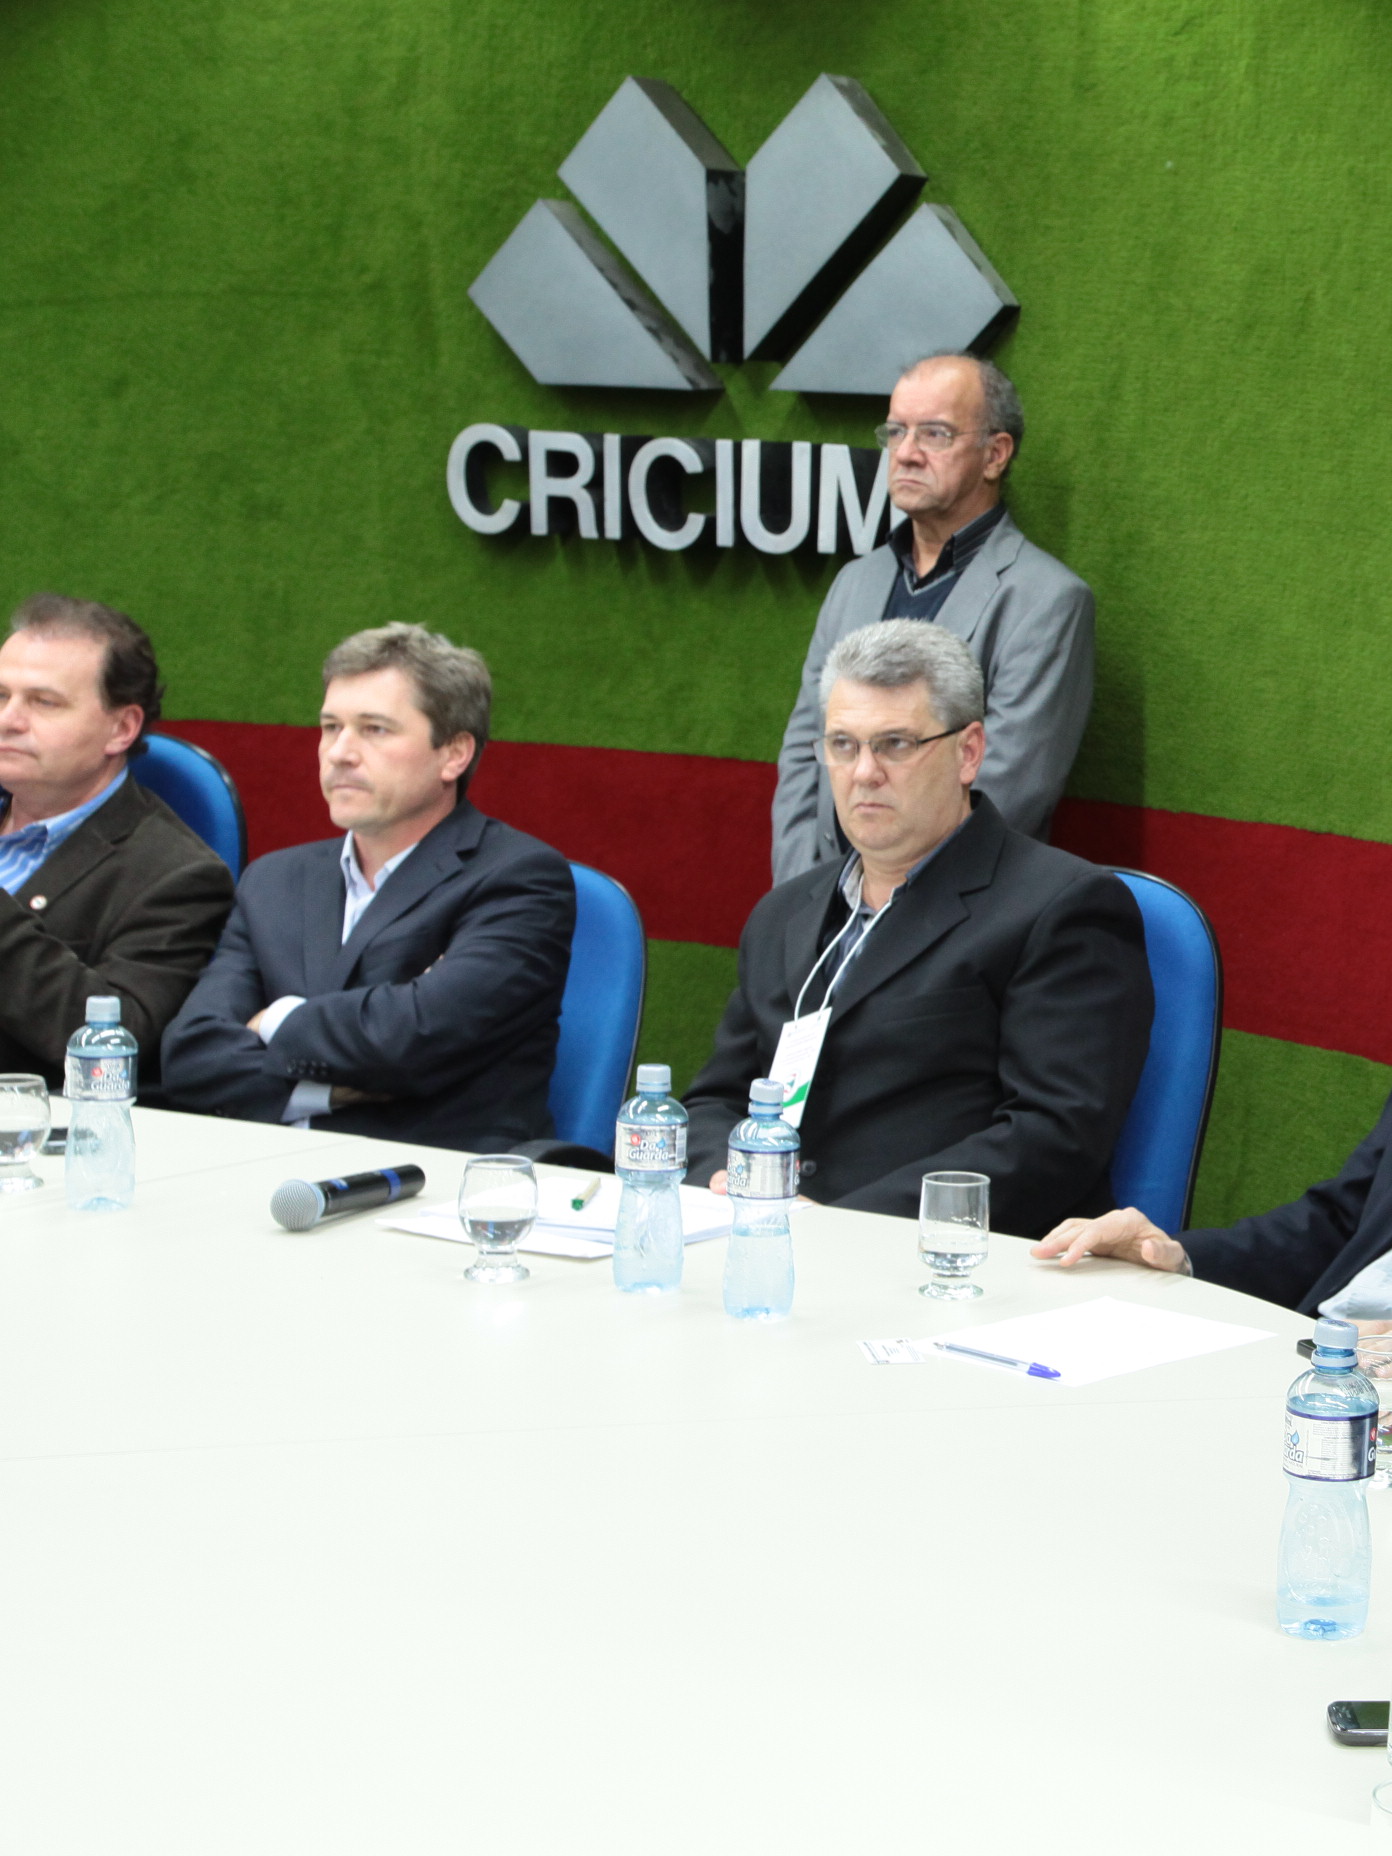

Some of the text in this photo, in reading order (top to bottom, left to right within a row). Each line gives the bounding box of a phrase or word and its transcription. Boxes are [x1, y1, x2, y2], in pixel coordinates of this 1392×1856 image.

[91, 1080, 130, 1090] Guarda
[640, 1139, 657, 1151] Da
[628, 1148, 669, 1161] Guarda
